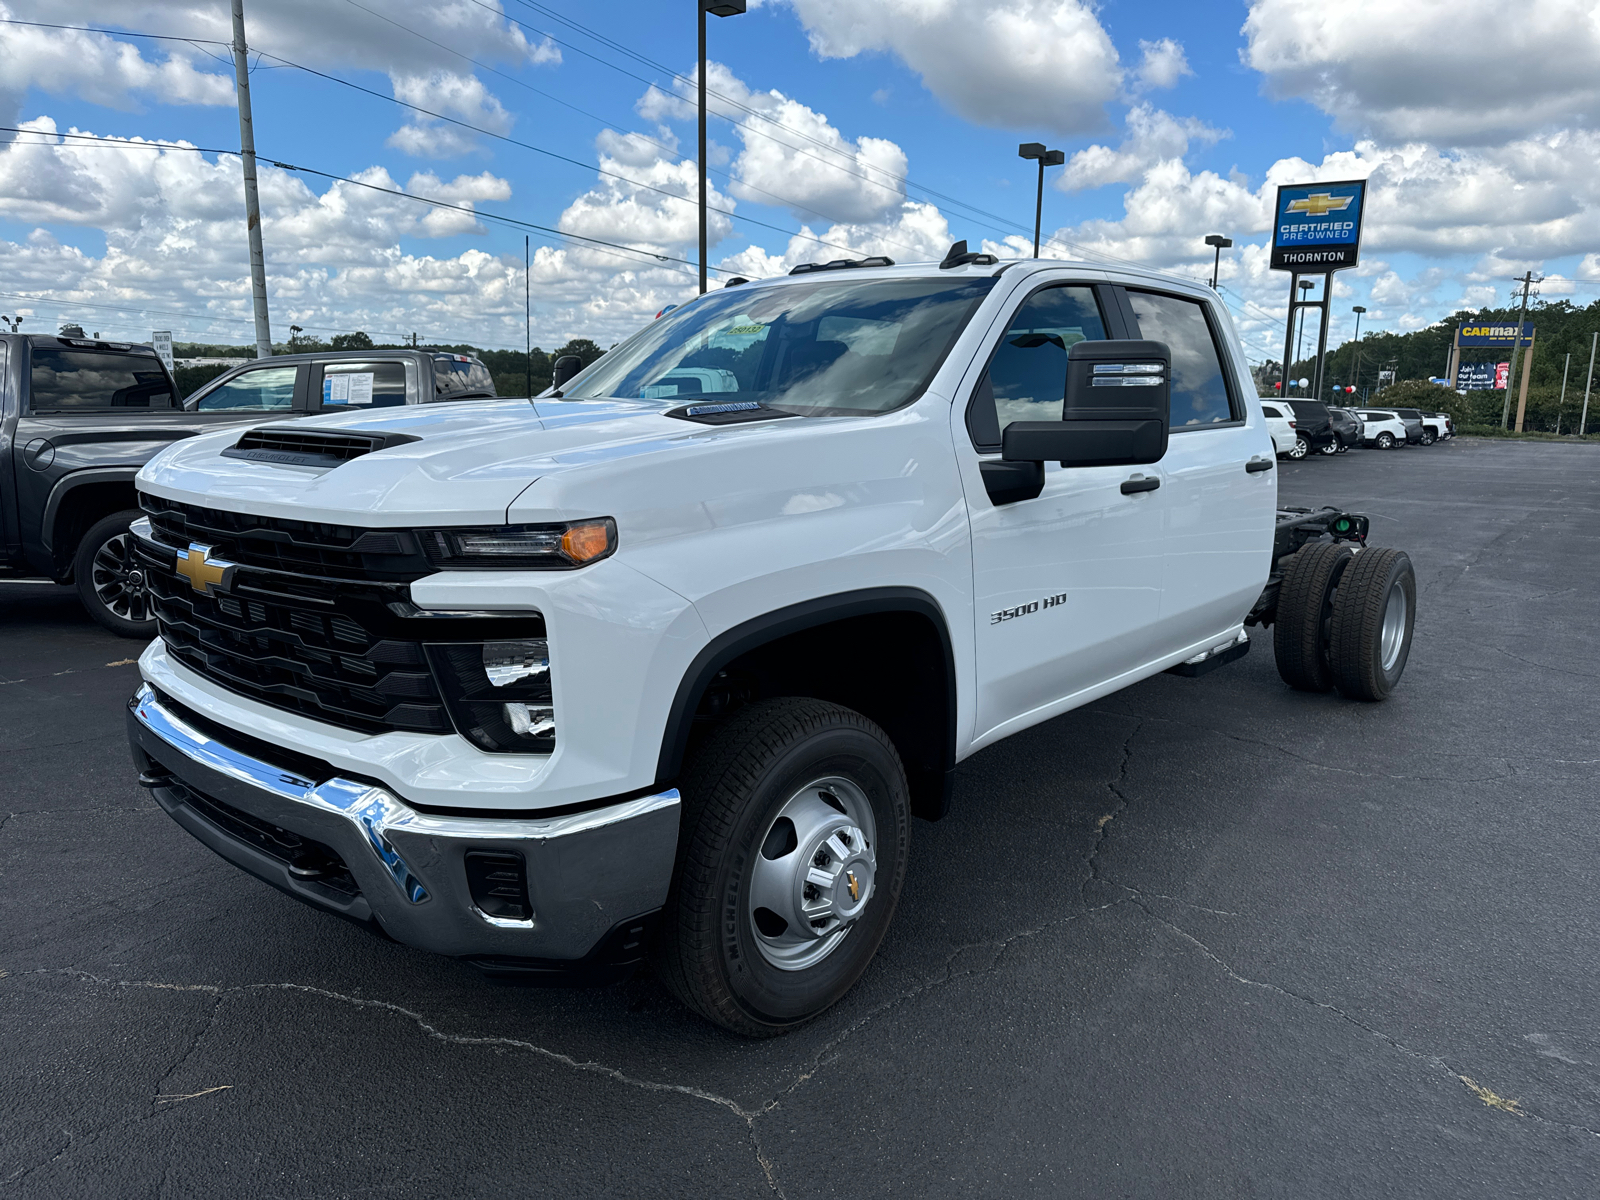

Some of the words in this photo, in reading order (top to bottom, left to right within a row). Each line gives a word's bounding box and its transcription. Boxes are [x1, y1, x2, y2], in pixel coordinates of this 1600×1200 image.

[1281, 221, 1354, 233] CERTIFIED
[1283, 230, 1349, 240] PRE-OWNED
[1283, 251, 1345, 263] THORNTON
[246, 451, 310, 463] CHEVROLET
[990, 600, 1039, 626] 3500
[1043, 591, 1067, 610] HD
[892, 802, 906, 892] MICHELIN
[725, 853, 745, 961] MICHELIN
